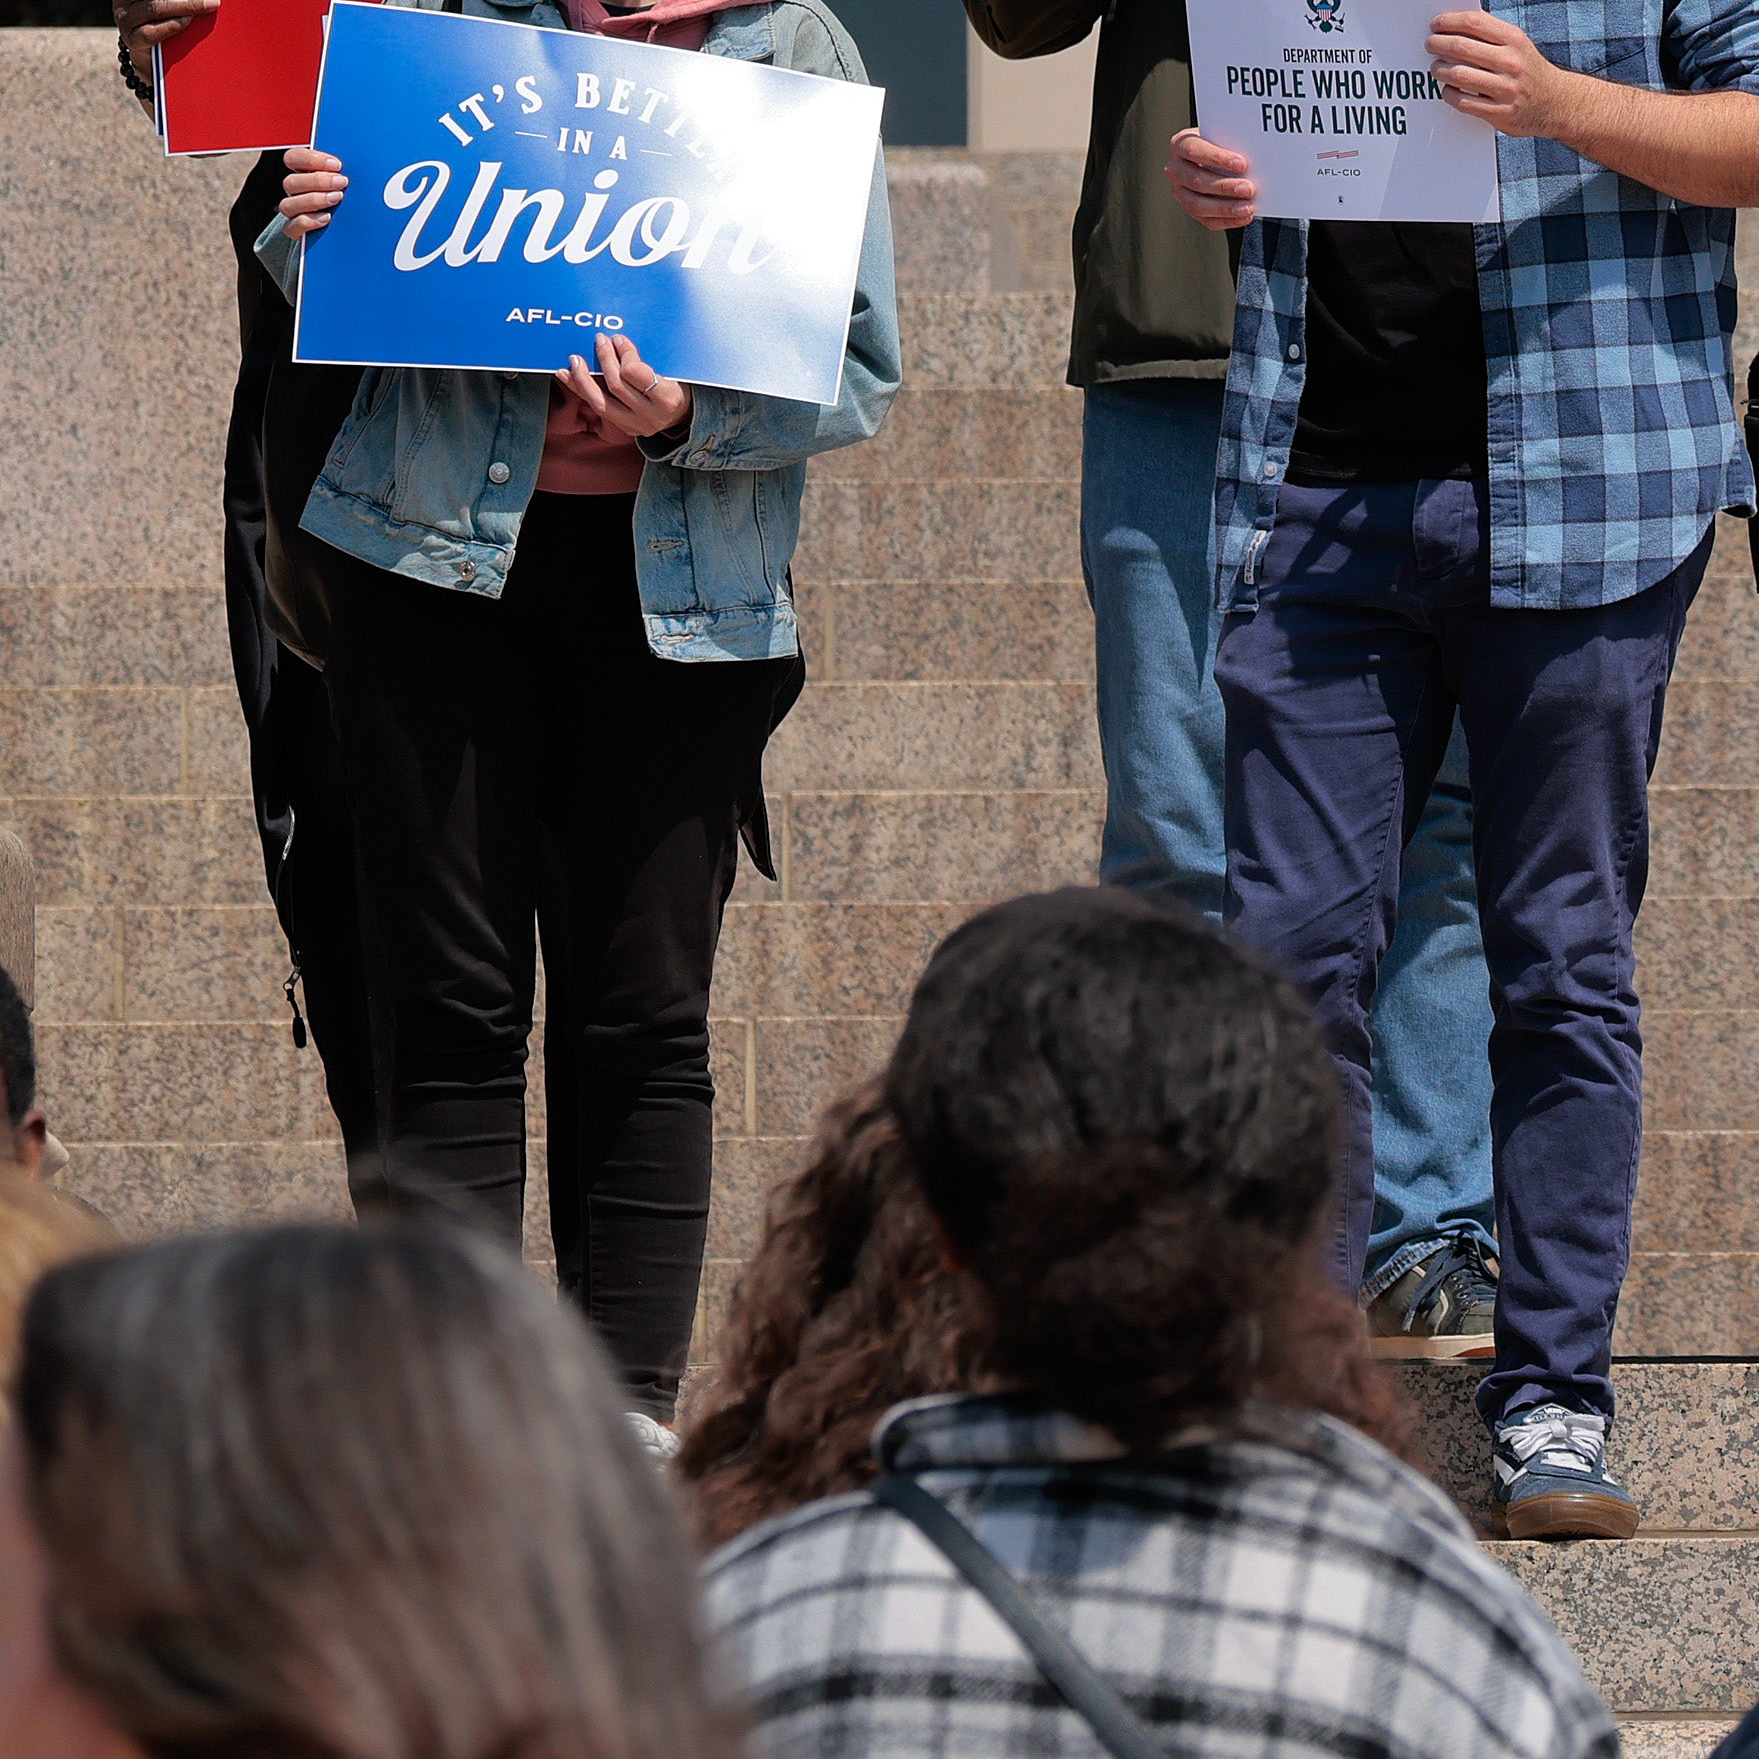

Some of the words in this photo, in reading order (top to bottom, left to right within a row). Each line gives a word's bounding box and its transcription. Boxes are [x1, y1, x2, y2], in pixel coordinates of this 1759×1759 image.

[1283, 48, 1355, 64] DEPARTMENT
[1358, 49, 1373, 64] OF
[1226, 65, 1306, 99] PEOPLE
[1312, 69, 1366, 100] WHO
[1373, 70, 1443, 100] WORK
[438, 74, 544, 147] IT'S
[575, 72, 742, 185] BETTE
[1261, 102, 1303, 134] FOR
[1310, 104, 1325, 134] A
[1332, 105, 1407, 136] LIVING
[557, 127, 593, 155] IN
[609, 135, 628, 161] A
[1316, 168, 1361, 177] AFL-CIO
[383, 159, 778, 274] Union
[505, 307, 625, 330] AFL-CIO
